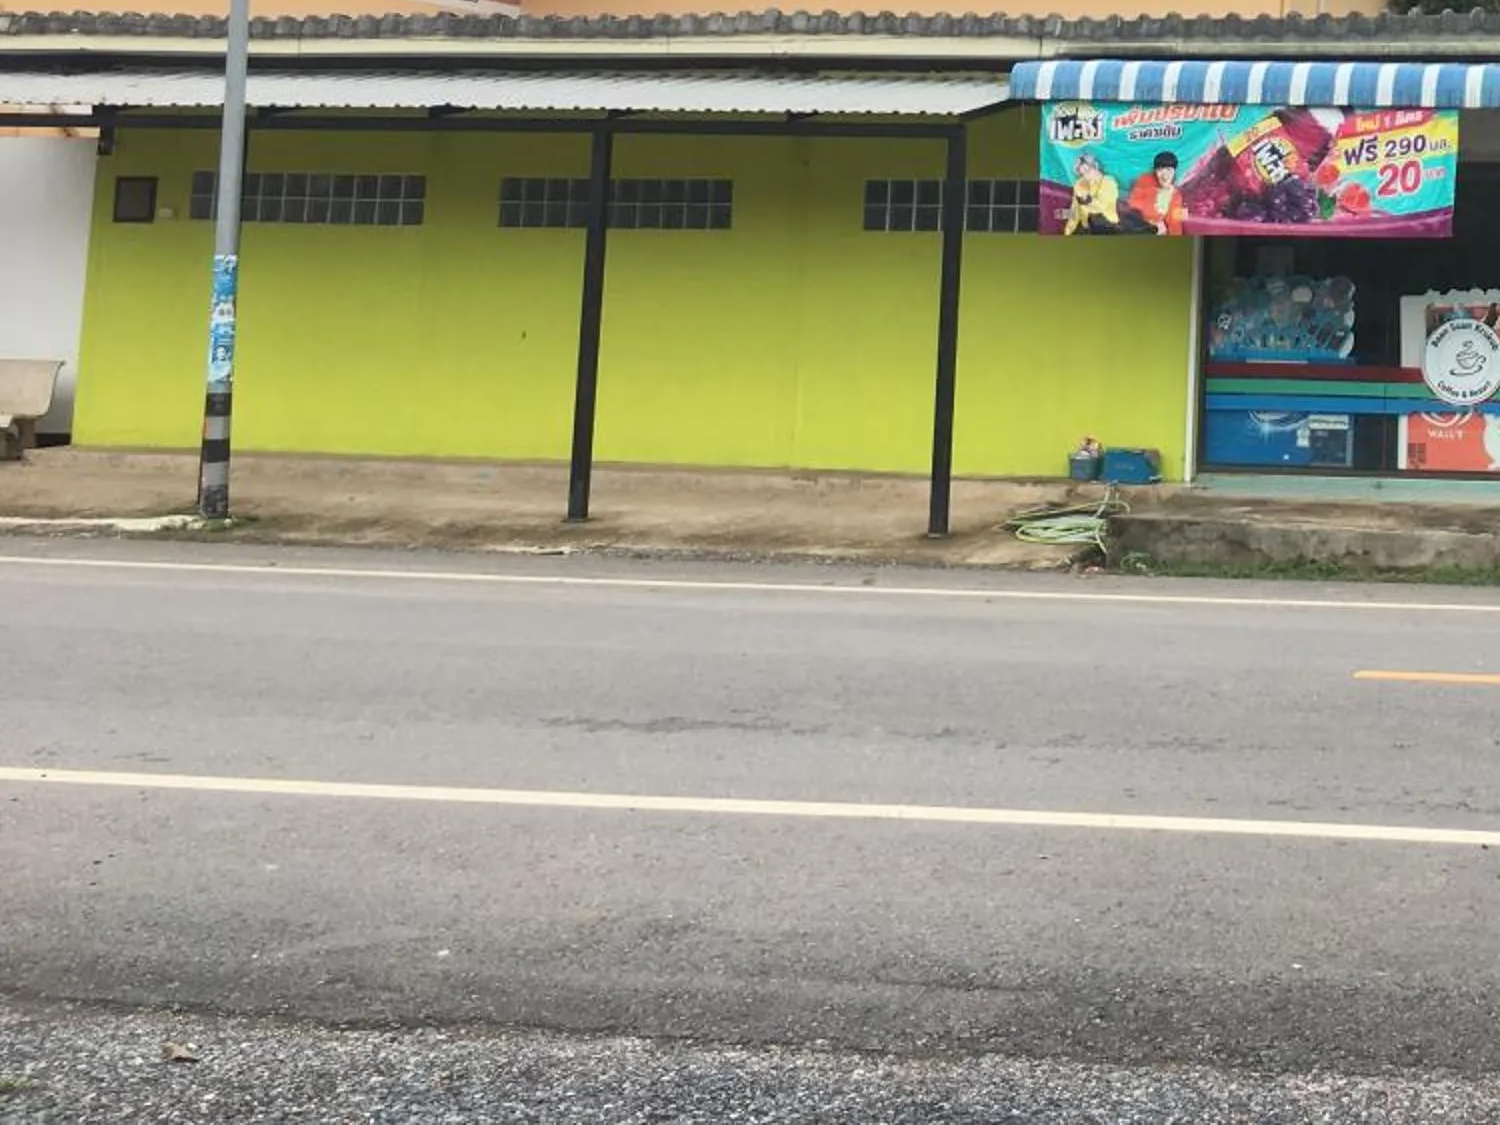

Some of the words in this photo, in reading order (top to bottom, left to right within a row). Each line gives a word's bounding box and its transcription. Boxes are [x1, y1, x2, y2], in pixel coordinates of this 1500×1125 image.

[1343, 134, 1379, 166] ฟรี
[1384, 134, 1427, 158] 290
[1377, 159, 1422, 197] 20
